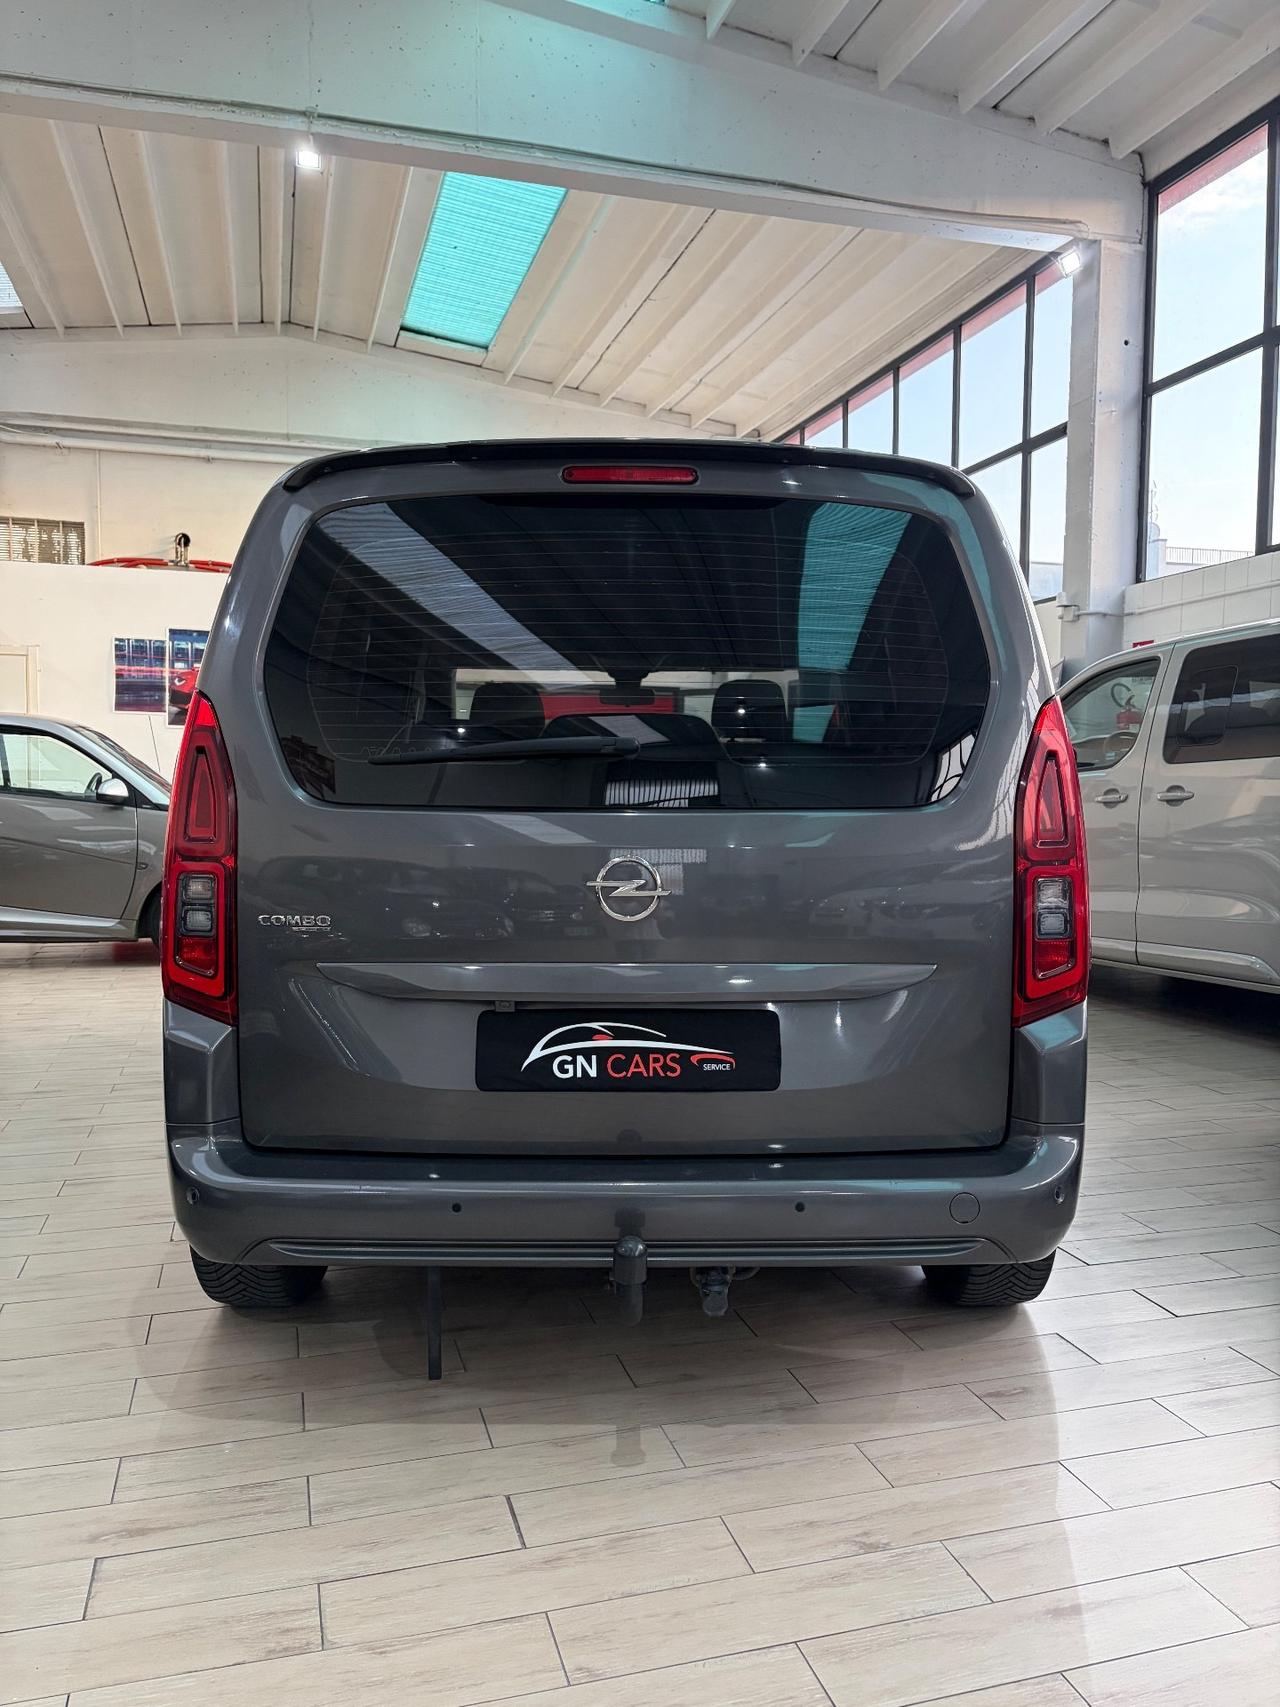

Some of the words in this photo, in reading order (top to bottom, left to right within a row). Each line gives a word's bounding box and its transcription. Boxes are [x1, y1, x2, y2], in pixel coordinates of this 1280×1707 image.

[258, 915, 331, 926] COMBO
[552, 1055, 597, 1078] GN
[606, 1053, 682, 1078] CARS
[702, 1063, 731, 1071] SERVICE
